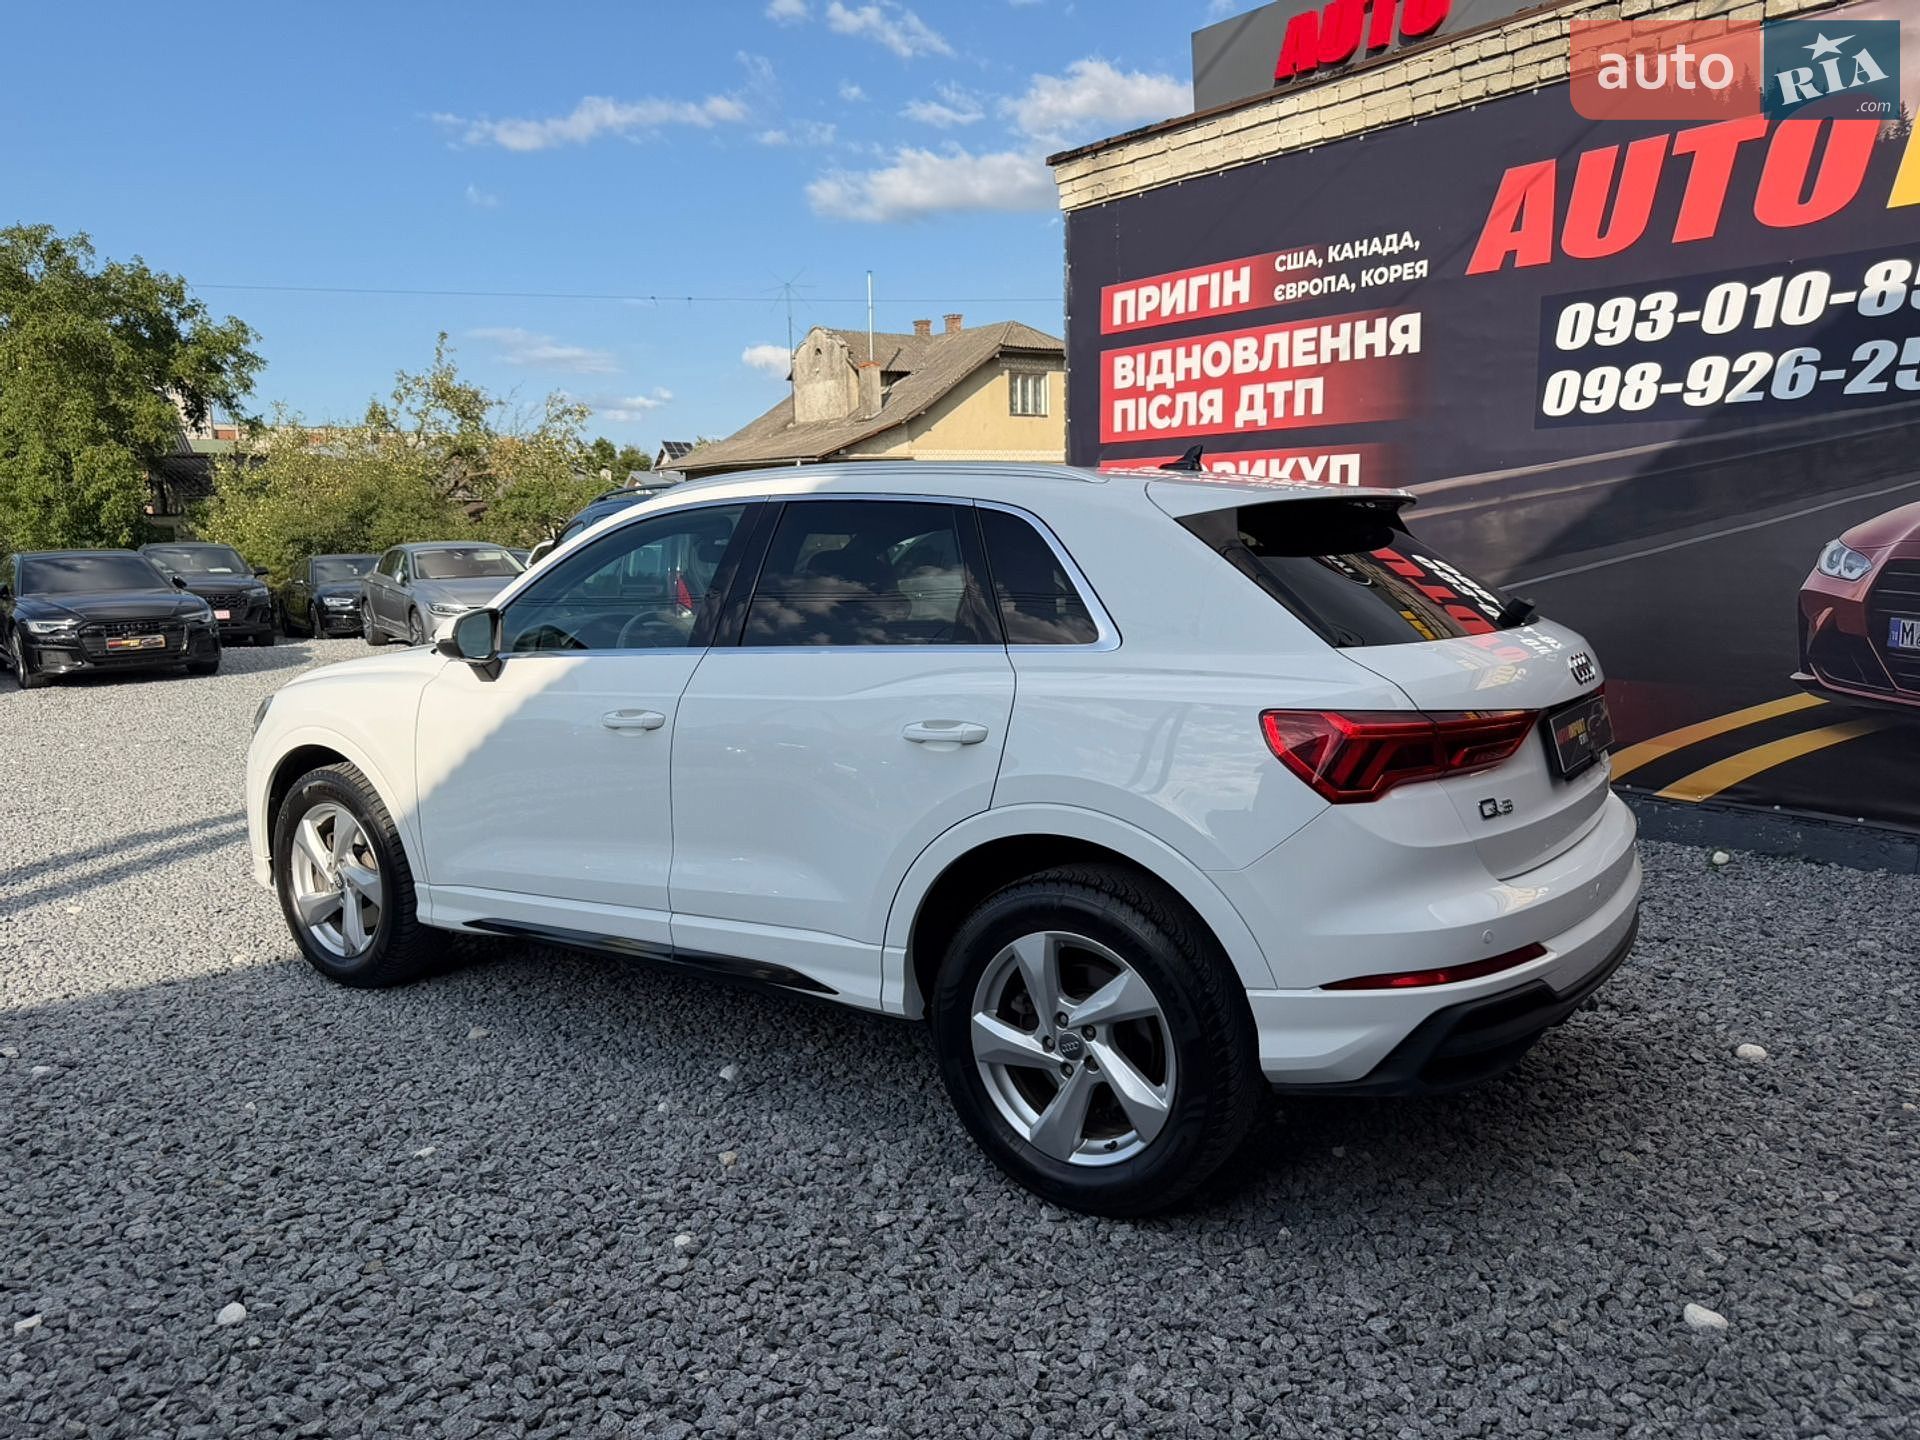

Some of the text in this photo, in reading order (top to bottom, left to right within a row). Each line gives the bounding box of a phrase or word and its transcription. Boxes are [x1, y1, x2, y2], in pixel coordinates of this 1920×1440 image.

[1274, 230, 1420, 272] США, КАНАДА,
[1112, 265, 1251, 326] ПРИГІН
[1273, 259, 1429, 302] ЄВРОПА, КОРЕЯ
[1555, 259, 1920, 351] 093-010-8
[1112, 311, 1422, 391] ВІДНОВЛЕННЯ
[1112, 376, 1324, 433] ПІСЛЯ ДТП
[1478, 797, 1514, 821] Q3
